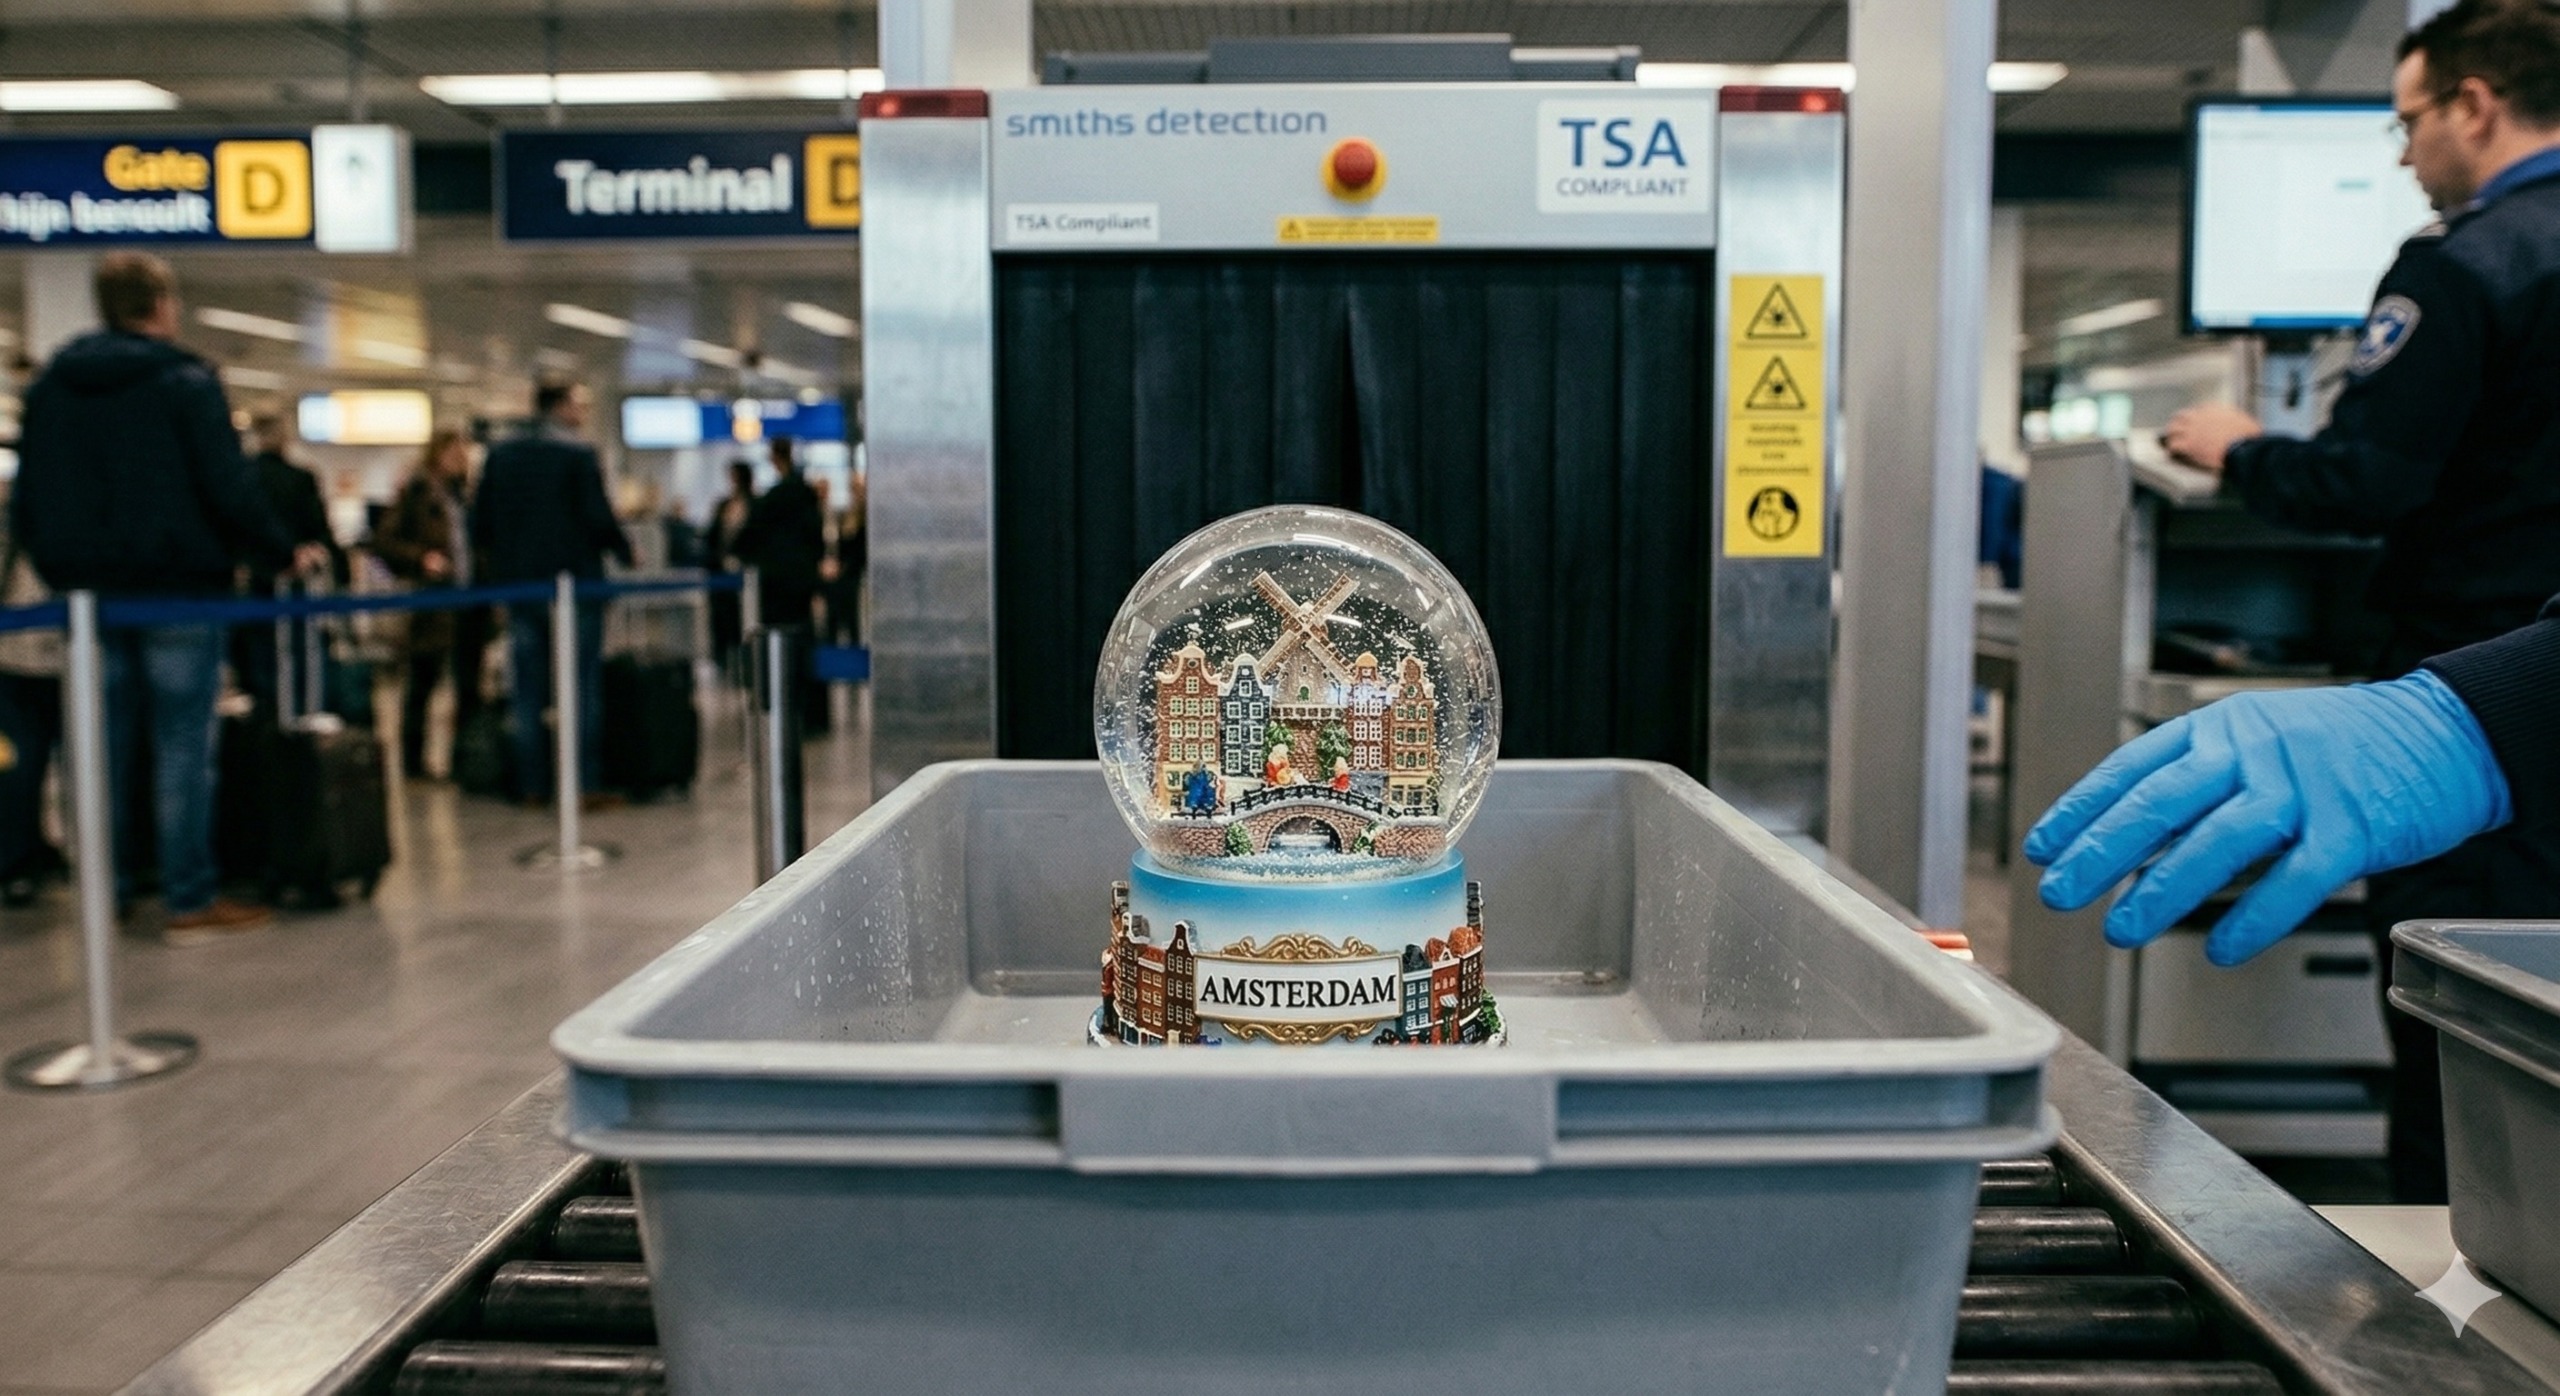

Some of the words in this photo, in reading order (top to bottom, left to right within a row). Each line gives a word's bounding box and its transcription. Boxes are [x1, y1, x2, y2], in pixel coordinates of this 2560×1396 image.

[1006, 108, 1135, 137] smiths
[1145, 108, 1327, 136] detection
[1559, 119, 1686, 168] TSA
[103, 144, 209, 191] Gate
[554, 155, 793, 214] Terminal
[1557, 177, 1688, 197] COMPLIANT
[242, 162, 287, 216] D
[1016, 214, 1048, 231] TSA
[1055, 213, 1151, 234] Compliant
[1200, 974, 1396, 1008] AMSTERDAM
